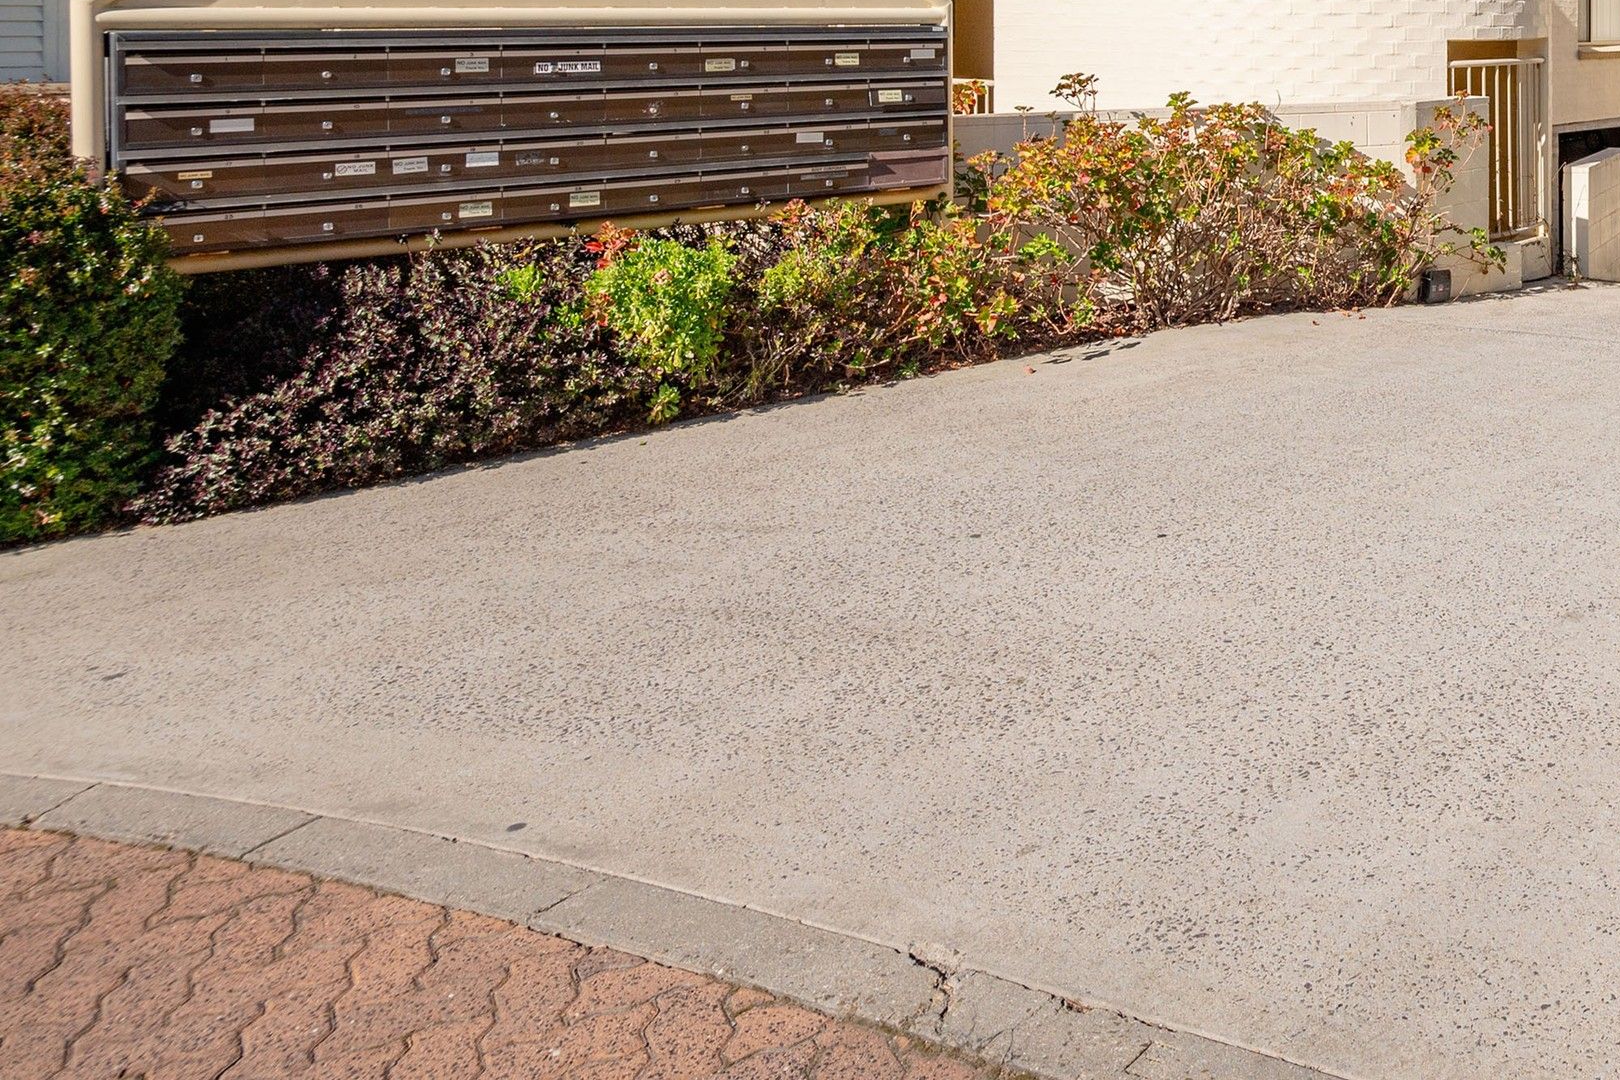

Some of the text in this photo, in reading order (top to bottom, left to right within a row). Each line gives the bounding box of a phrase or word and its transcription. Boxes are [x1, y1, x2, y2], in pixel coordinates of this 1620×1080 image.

[537, 62, 599, 72] NO JUNK MAIL
